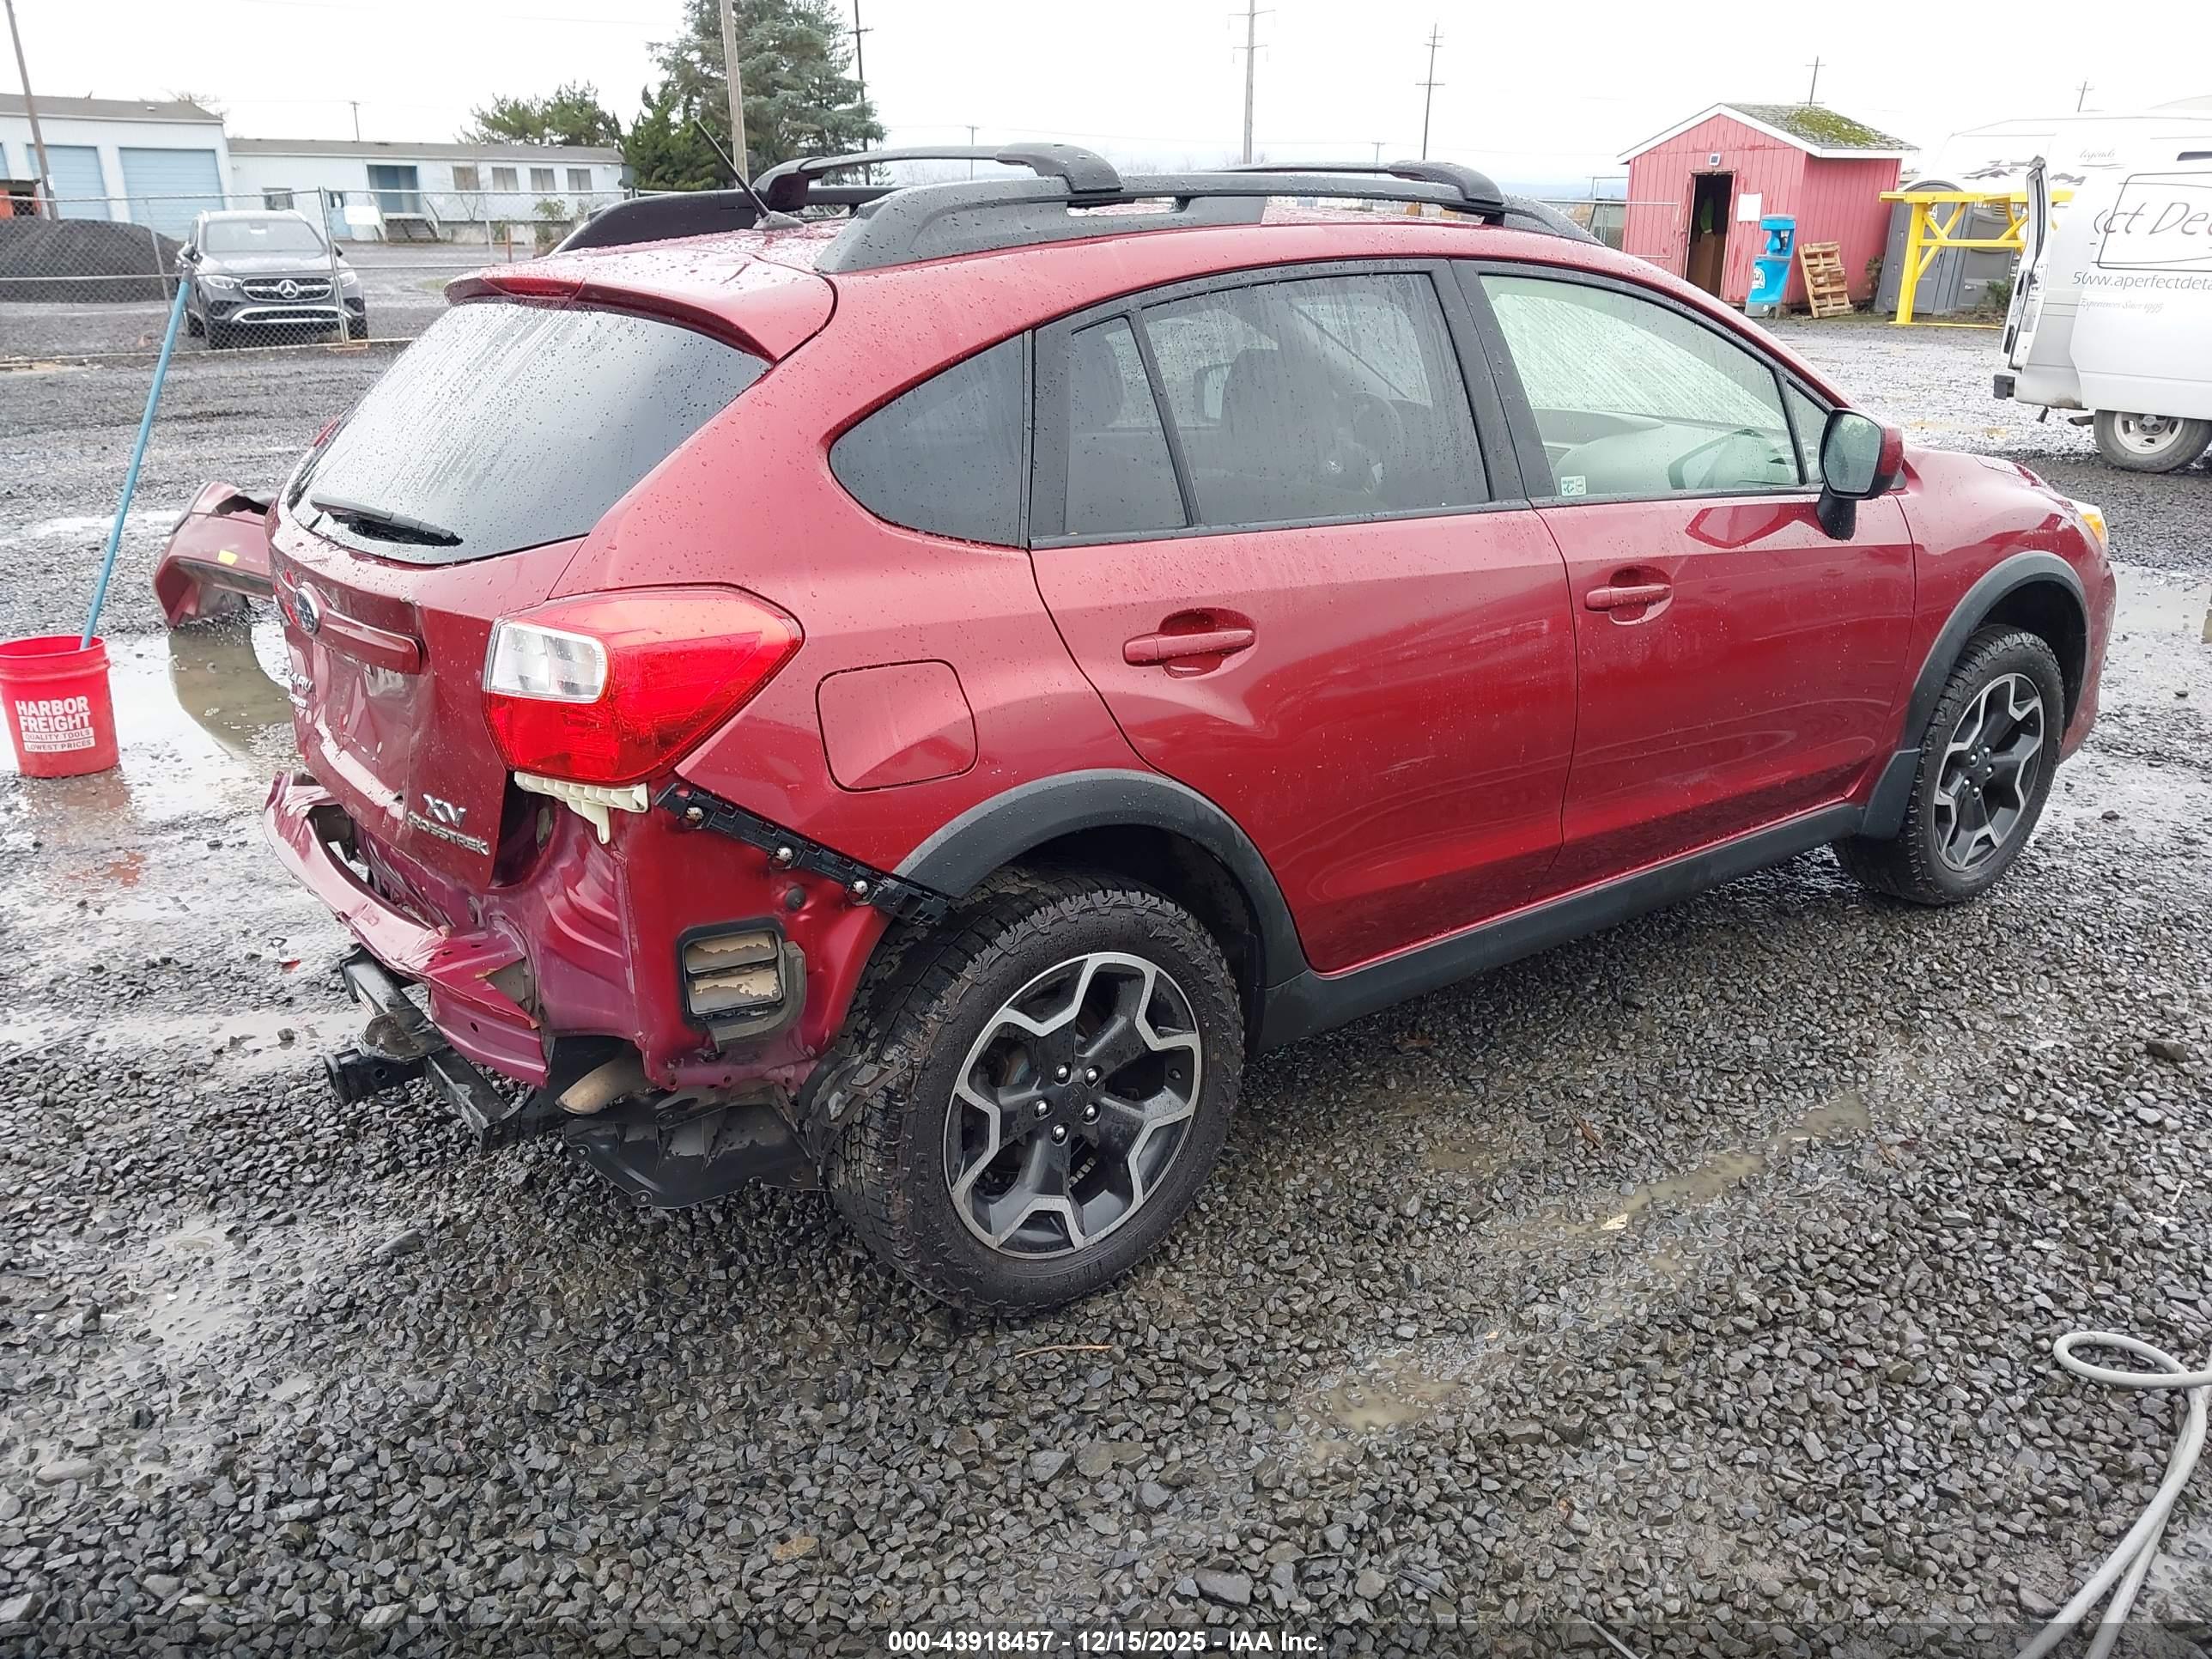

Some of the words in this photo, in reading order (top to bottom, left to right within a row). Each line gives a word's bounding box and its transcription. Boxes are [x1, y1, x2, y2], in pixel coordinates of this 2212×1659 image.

[2148, 202, 2212, 235] De
[15, 696, 89, 717] HARBOR
[20, 712, 91, 732] FREIGHT
[25, 732, 59, 741] QUALITY
[62, 730, 90, 738] TOOLS
[27, 742, 58, 750] LOWEST
[61, 740, 92, 750] PRICES
[422, 793, 467, 828] XV
[407, 810, 490, 856] CROSSTREK
